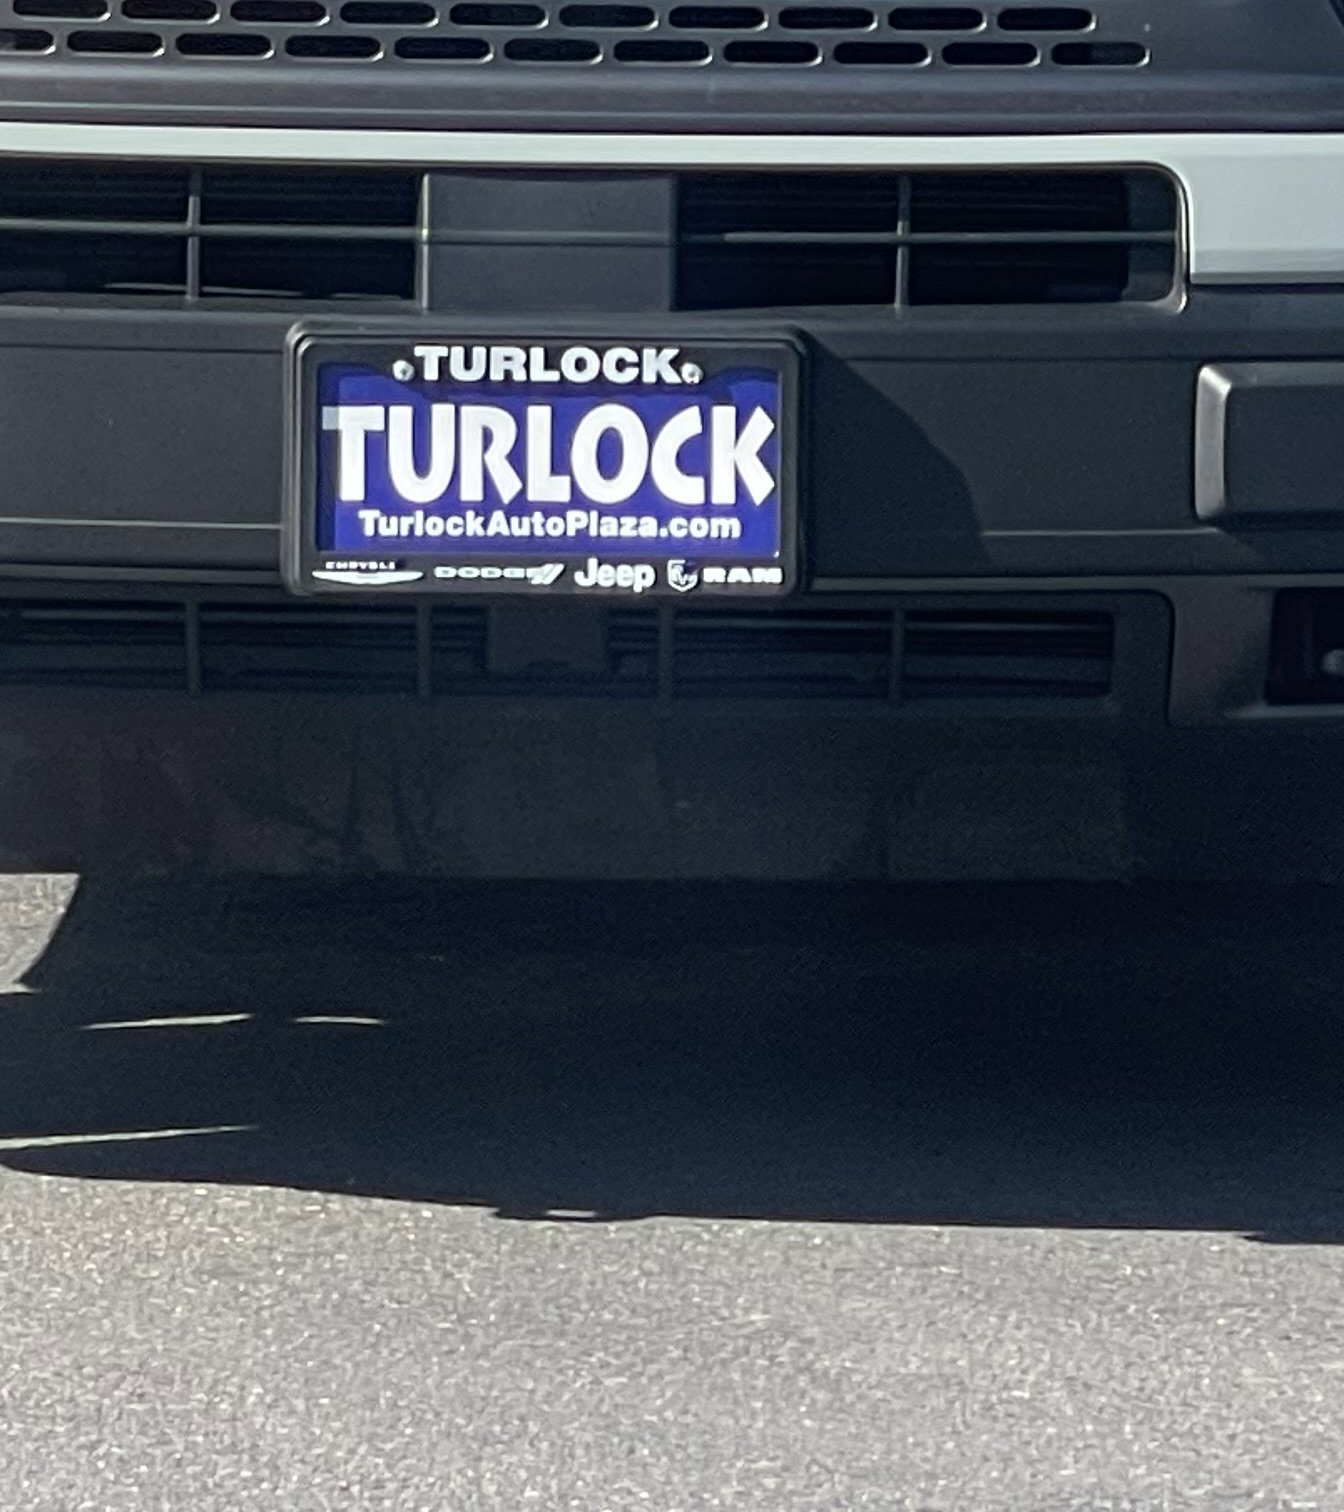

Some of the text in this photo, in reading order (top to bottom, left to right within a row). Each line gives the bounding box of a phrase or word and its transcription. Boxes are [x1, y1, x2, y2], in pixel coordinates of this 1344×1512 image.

[414, 346, 684, 384] TURLOCK
[322, 403, 775, 506] TURLOCK
[358, 509, 742, 539] TurlockAutoPlaza.com
[574, 557, 655, 592] Jeep
[703, 567, 783, 583] RAM
